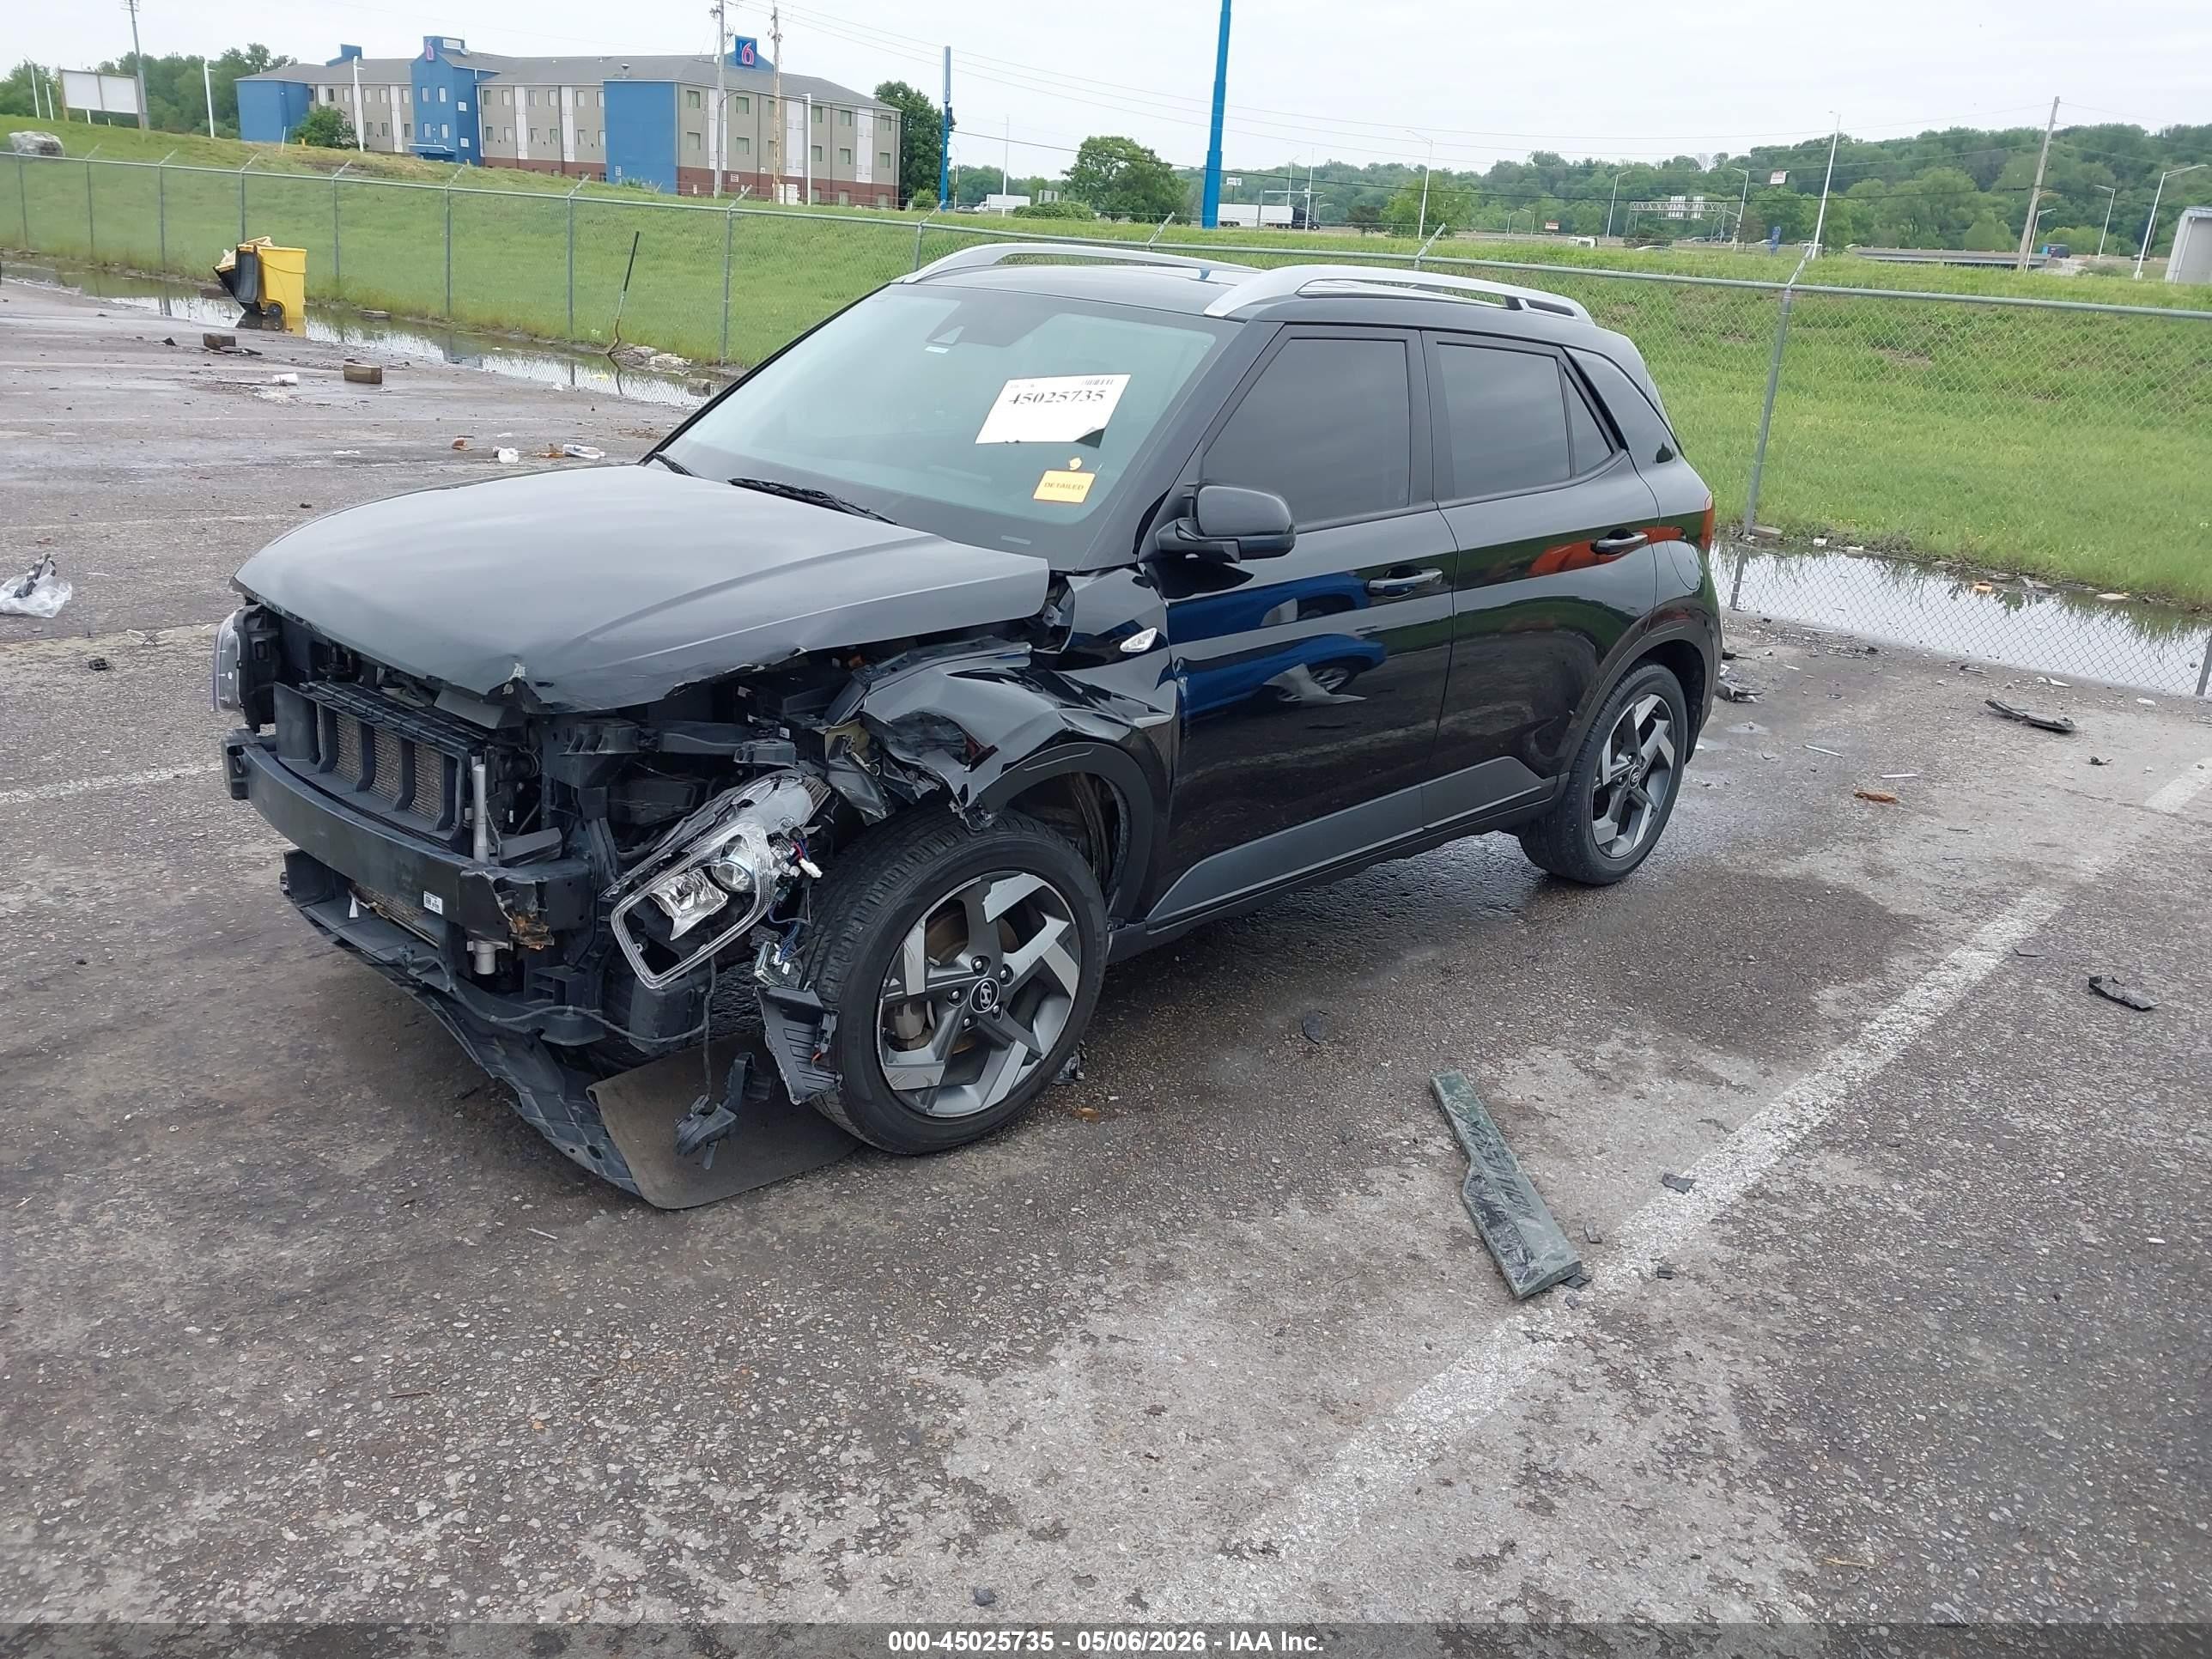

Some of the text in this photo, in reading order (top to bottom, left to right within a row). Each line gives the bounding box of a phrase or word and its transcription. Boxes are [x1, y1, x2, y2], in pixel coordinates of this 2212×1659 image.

[742, 42, 755, 65] 6
[1008, 390, 1107, 404] 45025735
[1043, 482, 1085, 490] DETAILED
